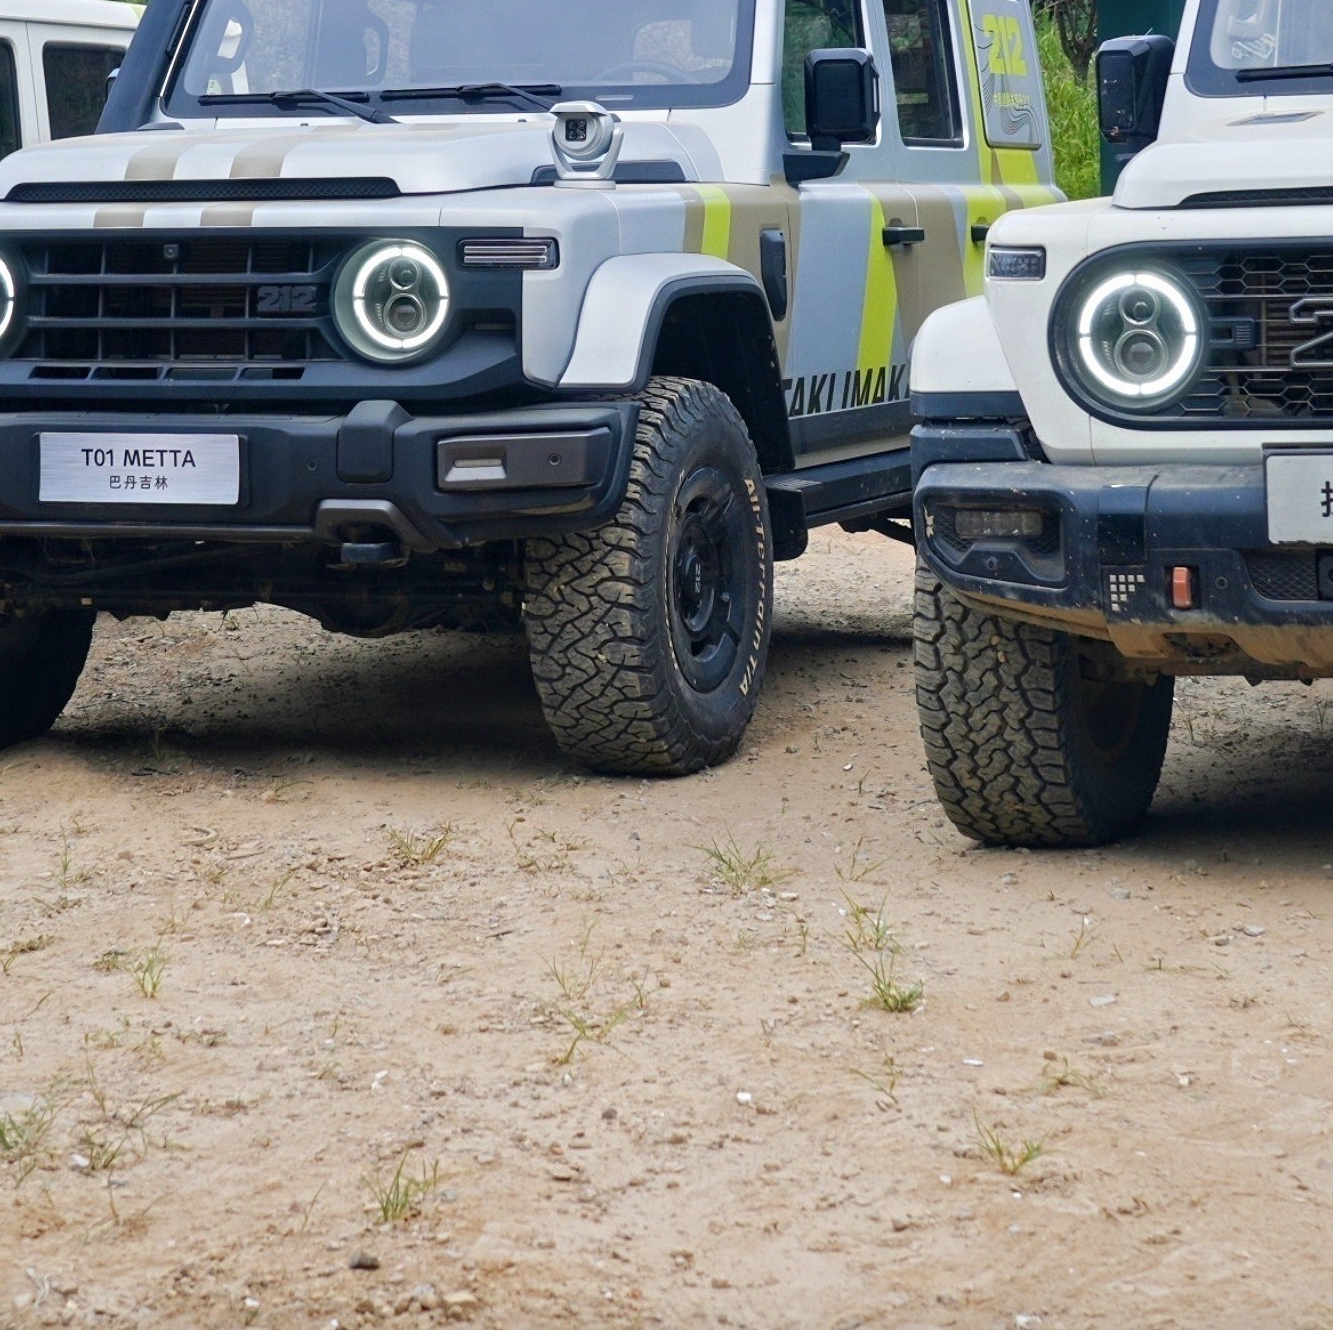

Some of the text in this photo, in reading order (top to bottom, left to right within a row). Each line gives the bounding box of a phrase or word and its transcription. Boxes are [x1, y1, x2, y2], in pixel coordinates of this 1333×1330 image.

[982, 13, 1028, 76] 212
[258, 286, 317, 312] 212
[81, 448, 196, 468] T01 METTA
[109, 475, 168, 490] 巴丹吉林
